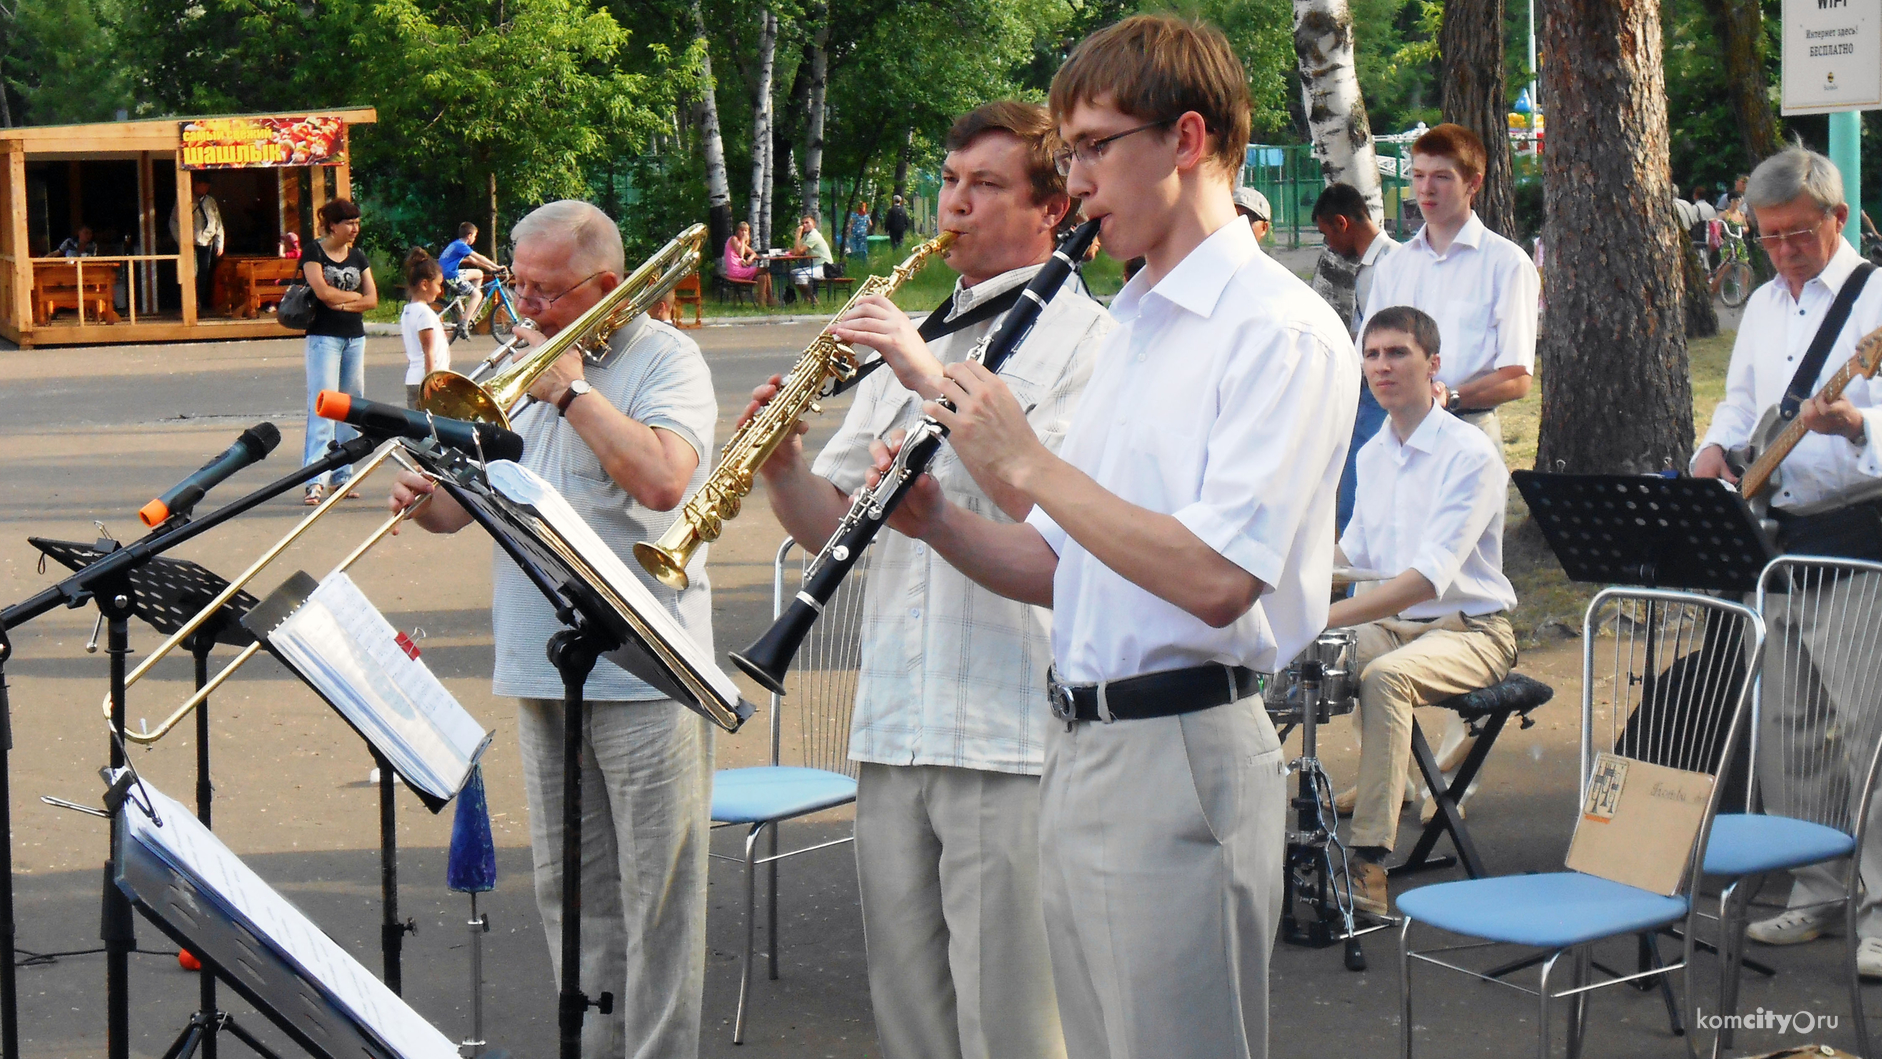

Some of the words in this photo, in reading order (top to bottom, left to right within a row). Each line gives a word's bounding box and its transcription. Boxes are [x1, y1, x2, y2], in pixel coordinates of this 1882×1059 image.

[1806, 29, 1836, 40] Интернет
[1810, 43, 1854, 57] БЕСПЛАТНО
[182, 128, 224, 142] самый
[227, 127, 272, 140] свежий
